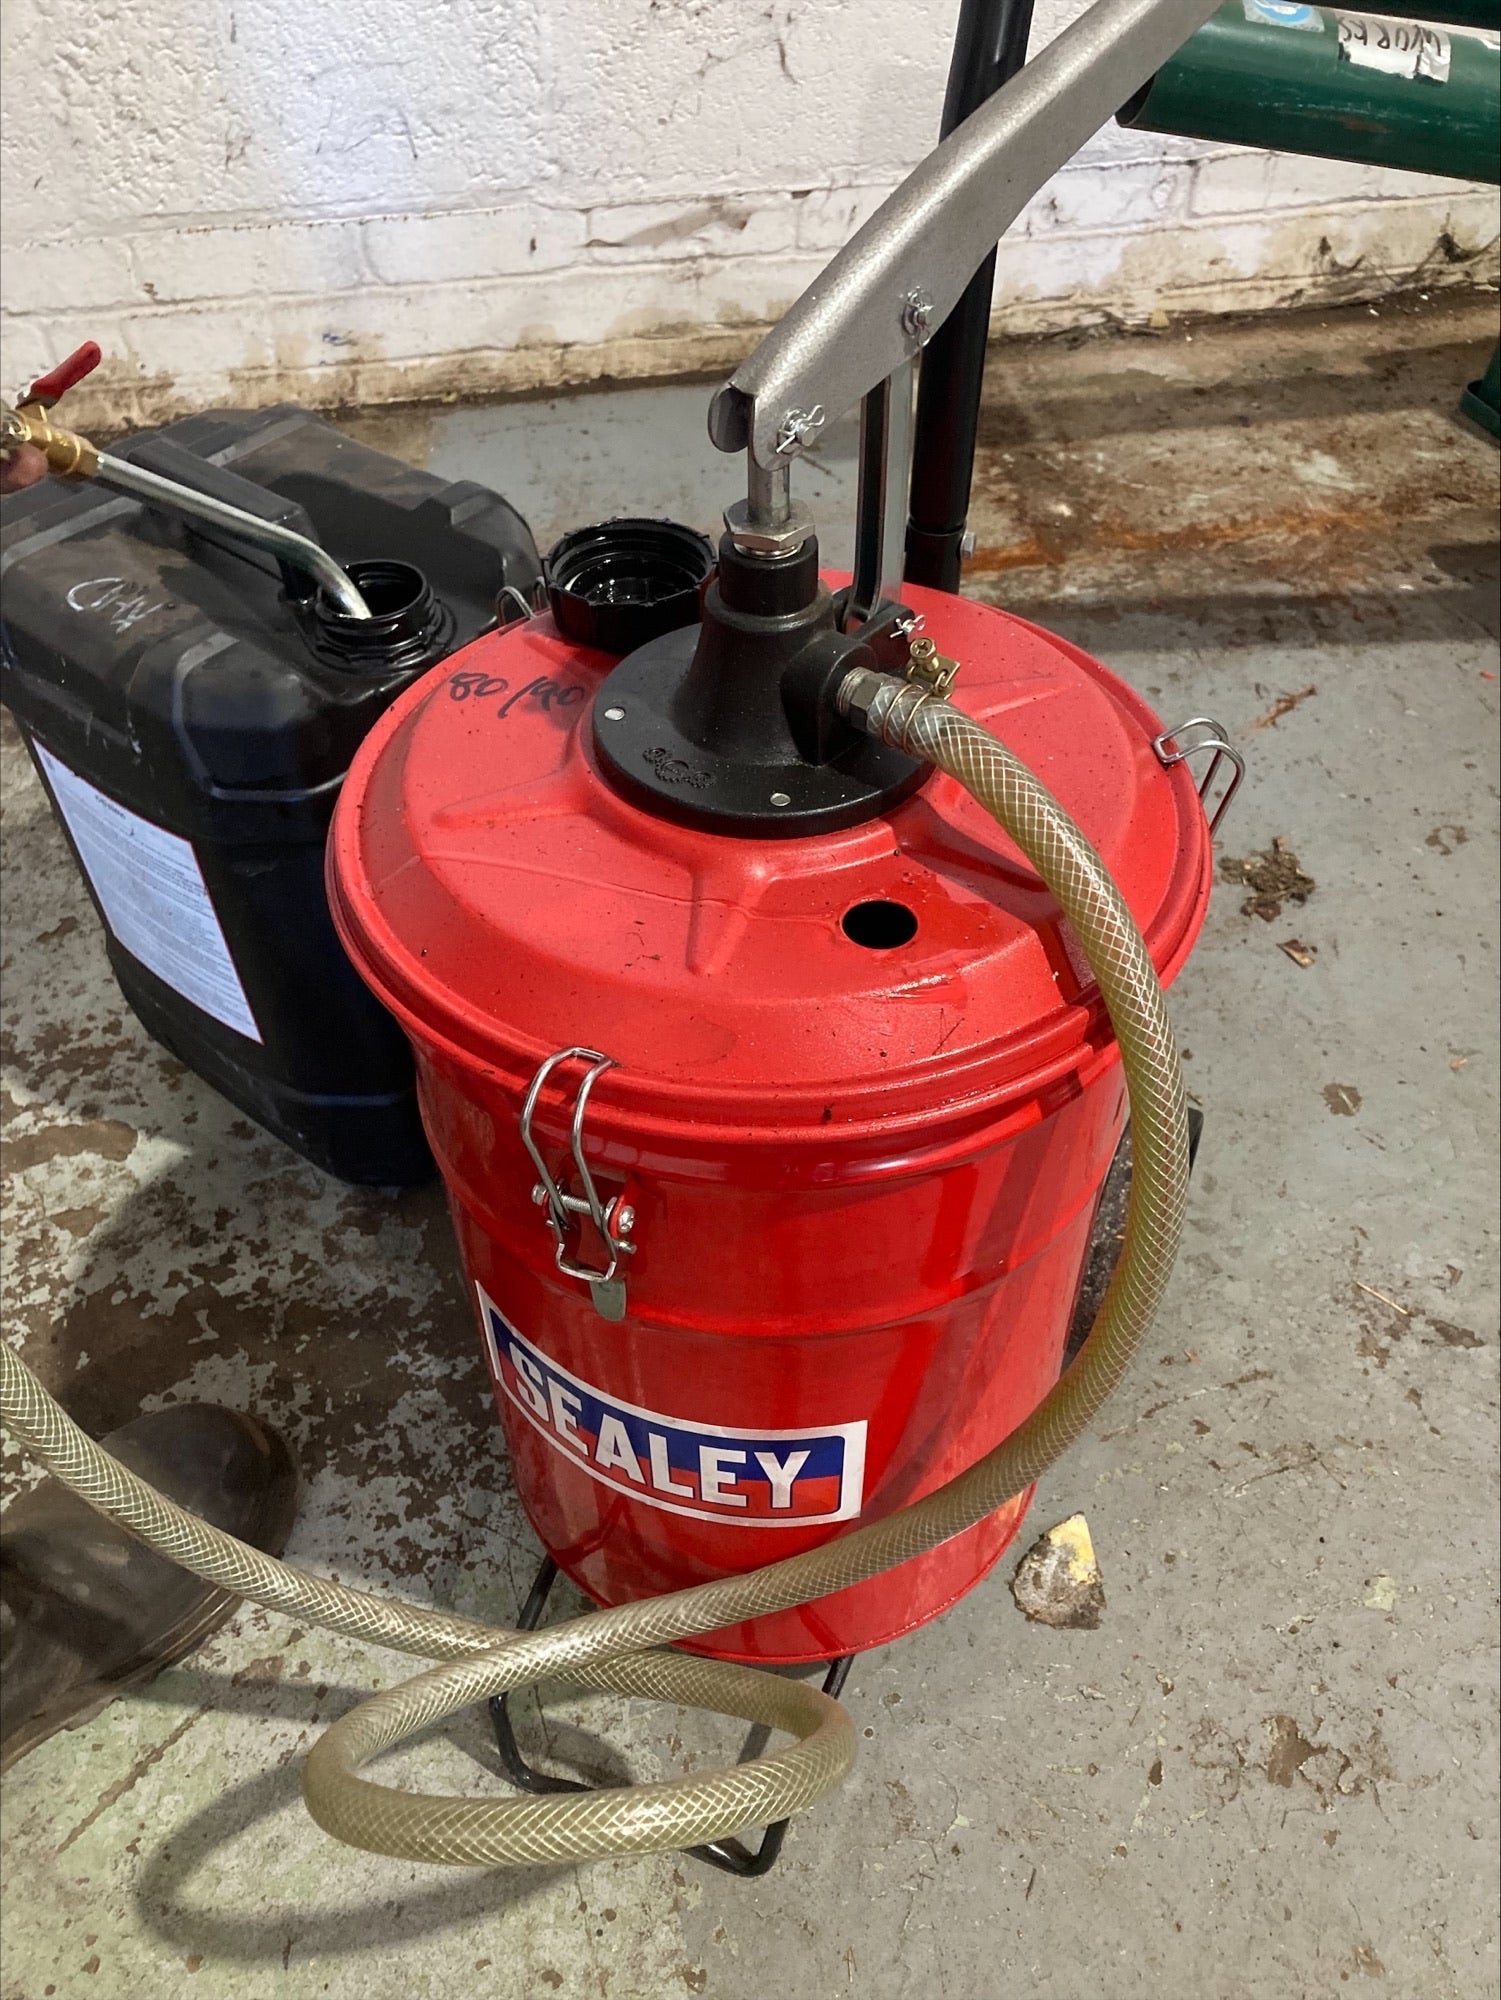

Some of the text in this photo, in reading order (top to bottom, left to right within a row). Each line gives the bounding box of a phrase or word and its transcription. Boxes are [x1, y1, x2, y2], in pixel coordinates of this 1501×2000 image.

[1338, 17, 1442, 57] WORKS
[449, 672, 587, 719] 80/90
[508, 1341, 811, 1509] SEALEY
